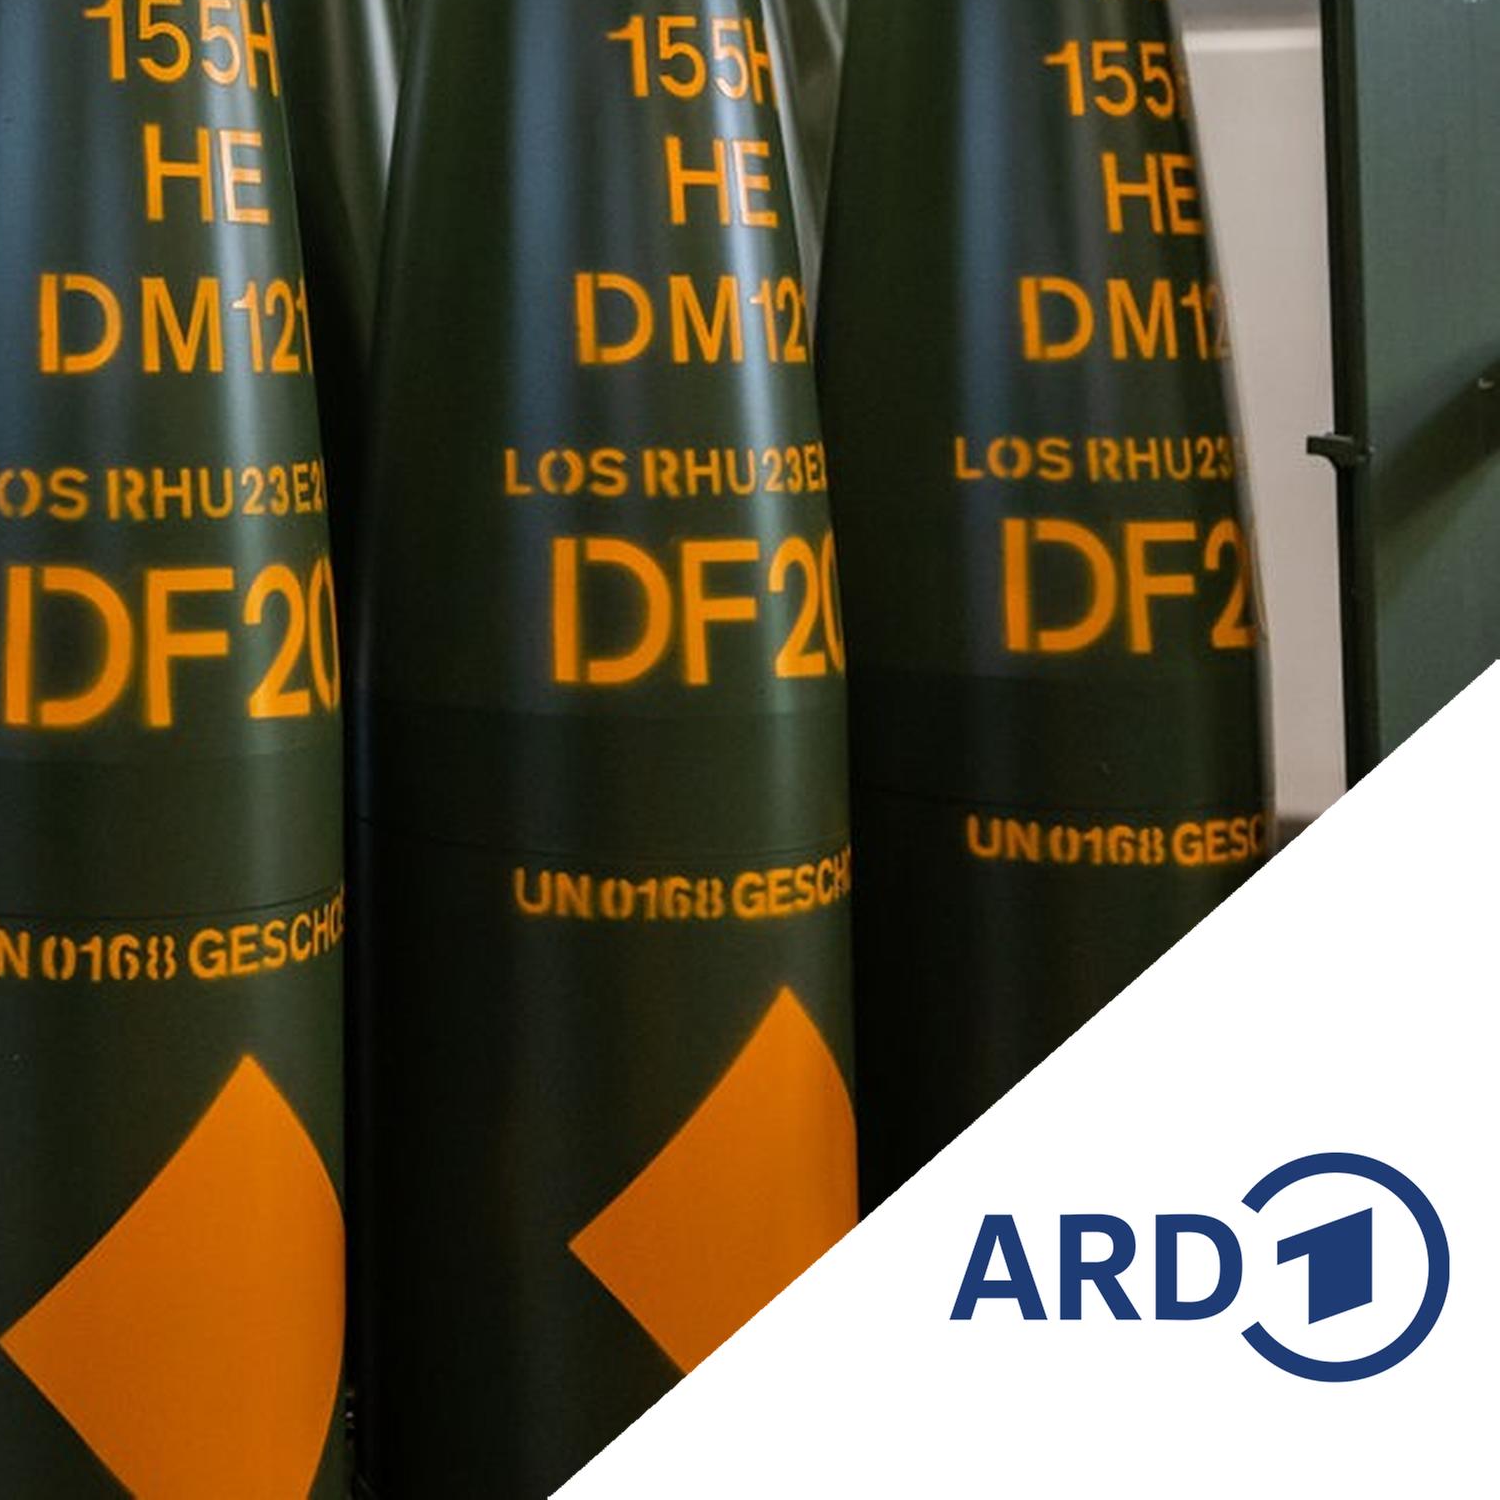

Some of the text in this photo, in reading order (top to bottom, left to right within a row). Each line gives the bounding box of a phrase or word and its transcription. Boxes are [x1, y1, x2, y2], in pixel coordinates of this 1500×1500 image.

[1044, 40, 1188, 119] 155
[143, 124, 270, 225] HE
[665, 135, 778, 228] HE
[1102, 152, 1204, 234] HE
[574, 272, 808, 364] DM12
[504, 447, 628, 496] LOS
[954, 436, 1074, 482] LOS
[1001, 517, 1270, 655] DF2
[4, 557, 341, 727] DF20
[966, 814, 1041, 863] UN
[1049, 825, 1164, 865] 0168
[513, 867, 593, 920] UN
[601, 875, 725, 920] 0168
[40, 933, 177, 982] 0168
